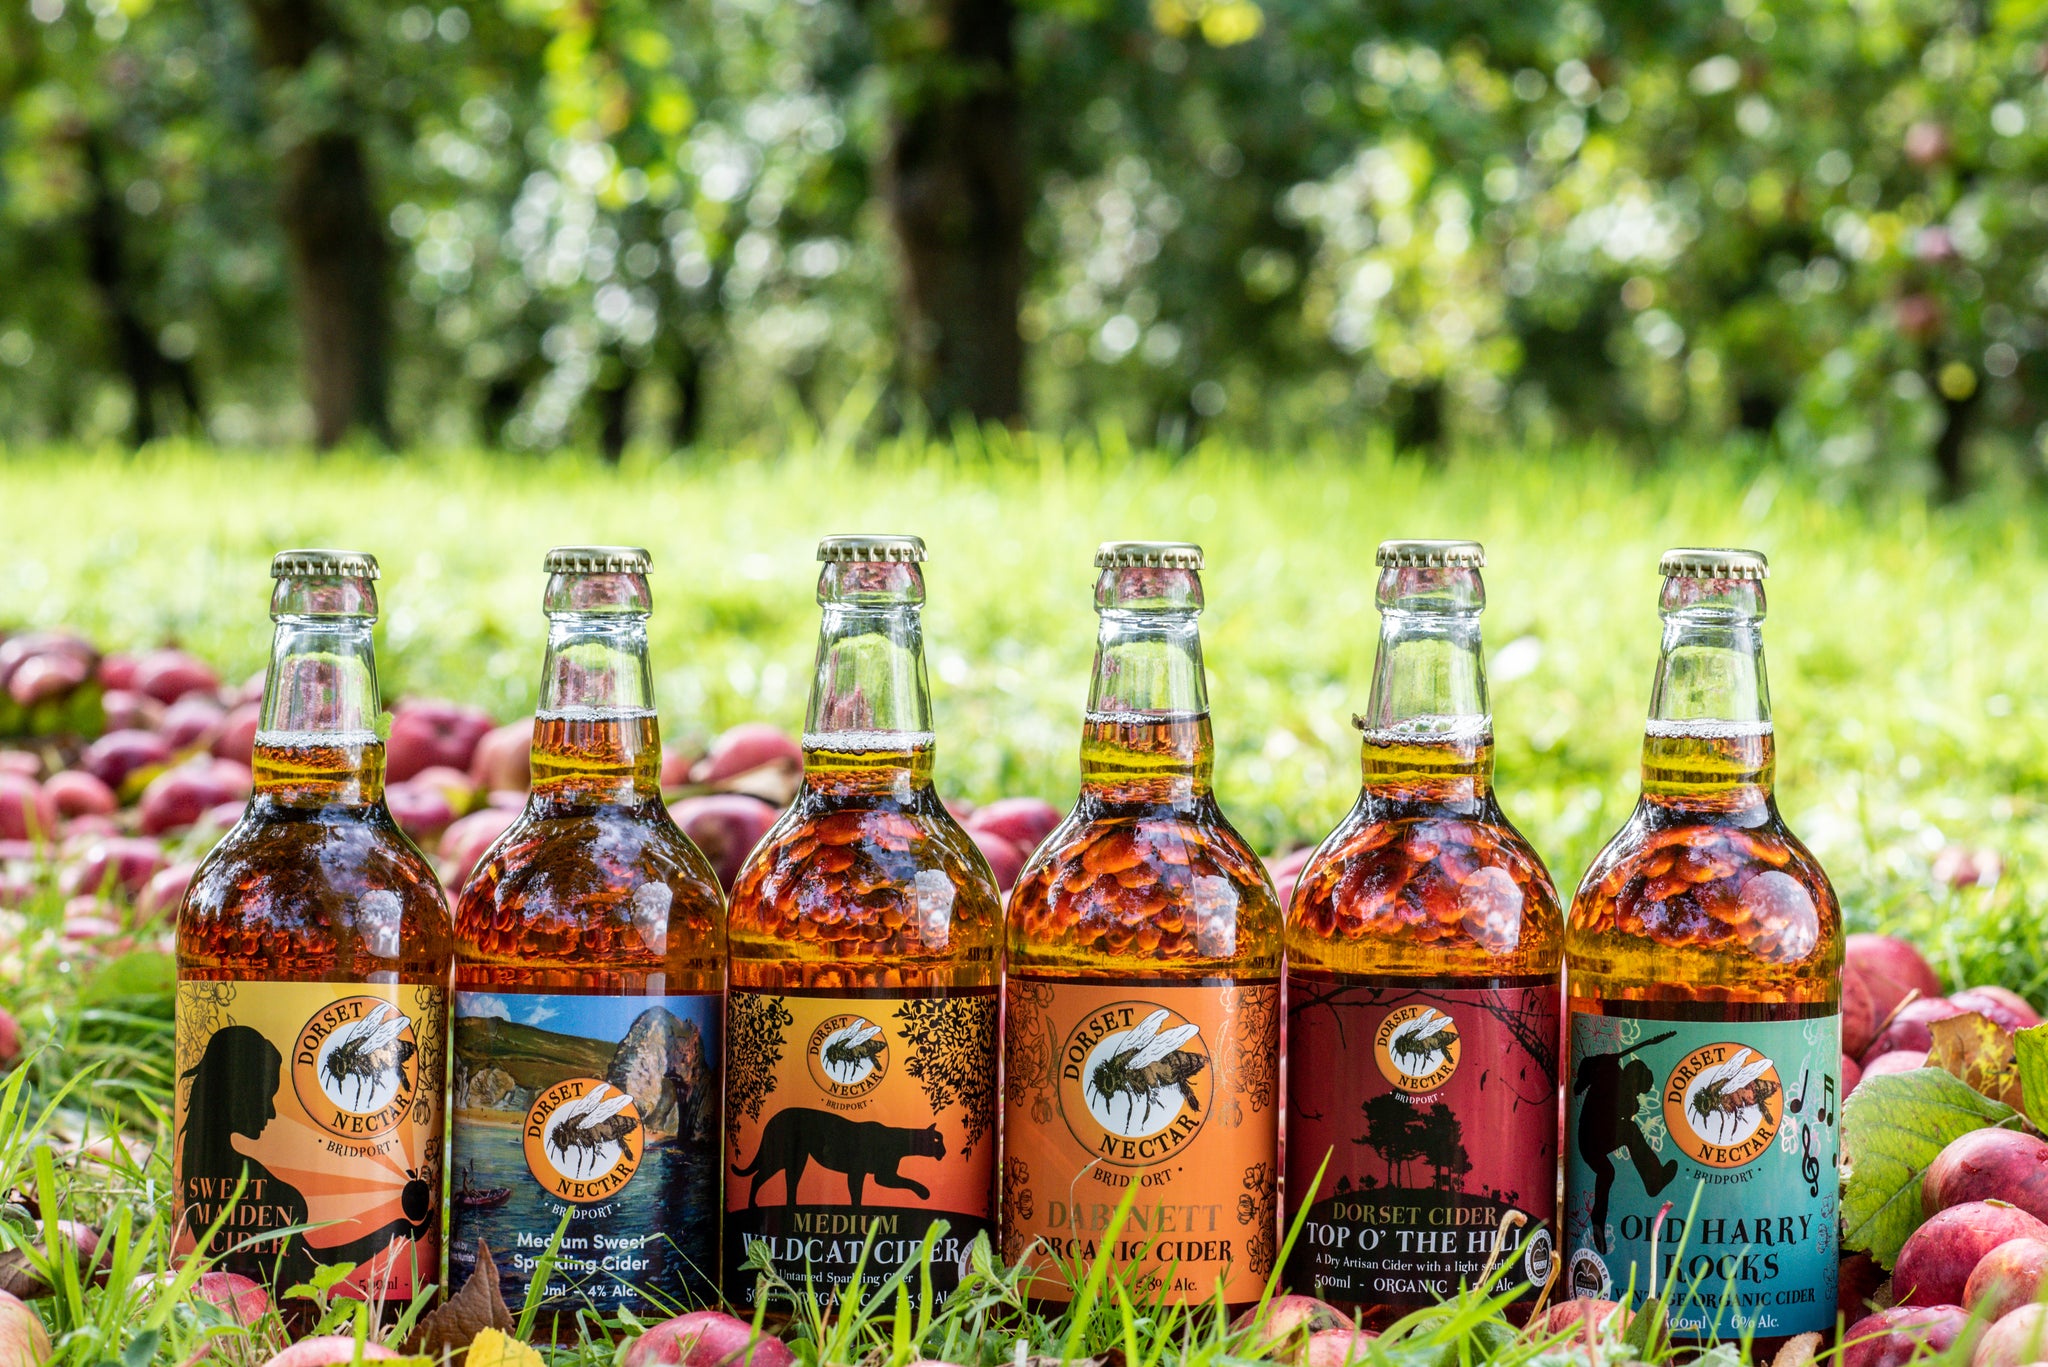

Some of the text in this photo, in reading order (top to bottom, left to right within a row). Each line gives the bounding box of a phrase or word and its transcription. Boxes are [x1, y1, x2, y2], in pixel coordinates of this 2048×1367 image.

[298, 1001, 363, 1066] DORSET
[809, 1017, 848, 1055] DORSET
[1377, 1006, 1418, 1047] DORSET
[1063, 1007, 1134, 1082] DORSET
[828, 1072, 882, 1097] NECTAR
[1397, 1064, 1454, 1089] NECTAR
[1668, 1047, 1727, 1104] DORSET
[527, 1081, 584, 1139] DORSET
[826, 1099, 868, 1111] BRIDPORT
[1394, 1092, 1439, 1104] BRIDPORT
[331, 1093, 411, 1134] NECTAR
[326, 1140, 392, 1158] BRIDPORT
[1098, 1112, 1200, 1160] NECTAR
[1697, 1126, 1774, 1163] NECTAR
[555, 1160, 635, 1198] NECTAR
[1693, 1168, 1754, 1185] BRIDPORT
[551, 1203, 612, 1220] BRDPORT
[793, 1212, 899, 1236] MEDIUM
[1047, 1200, 1223, 1233] DABNETT
[1333, 1201, 1499, 1227] DORSET CIDER
[516, 1232, 645, 1250] Medum Sweet
[1306, 1221, 1351, 1248] TOP
[1395, 1230, 1457, 1254] THE
[1620, 1213, 1814, 1246] OLD HARRY
[210, 1230, 291, 1258] CIDER
[741, 1231, 864, 1265] WLDCAT
[1035, 1234, 1234, 1263] ORGAIC CIDER
[513, 1254, 650, 1275] Spkling Cider
[1316, 1252, 1514, 1275] A Dry Artisan Cider with a light sarke
[1591, 1254, 1608, 1280] CIDER
[1663, 1251, 1780, 1284] ROCKS
[358, 1276, 398, 1292] 50ml
[523, 1284, 566, 1297] 50ml
[587, 1285, 607, 1297] 4%
[612, 1284, 638, 1297] Alc.
[826, 1271, 881, 1287] Sparing
[883, 1271, 914, 1283] Cer
[1174, 1277, 1198, 1291] Alc.
[1314, 1274, 1351, 1289] 500ml
[1373, 1277, 1448, 1294] ORGANIC
[1615, 1287, 1816, 1309] VNTGE ORGANIC CIDER
[1667, 1315, 1707, 1329] 00ml
[1730, 1314, 1754, 1329] 6%
[1757, 1314, 1780, 1329] Alc.
